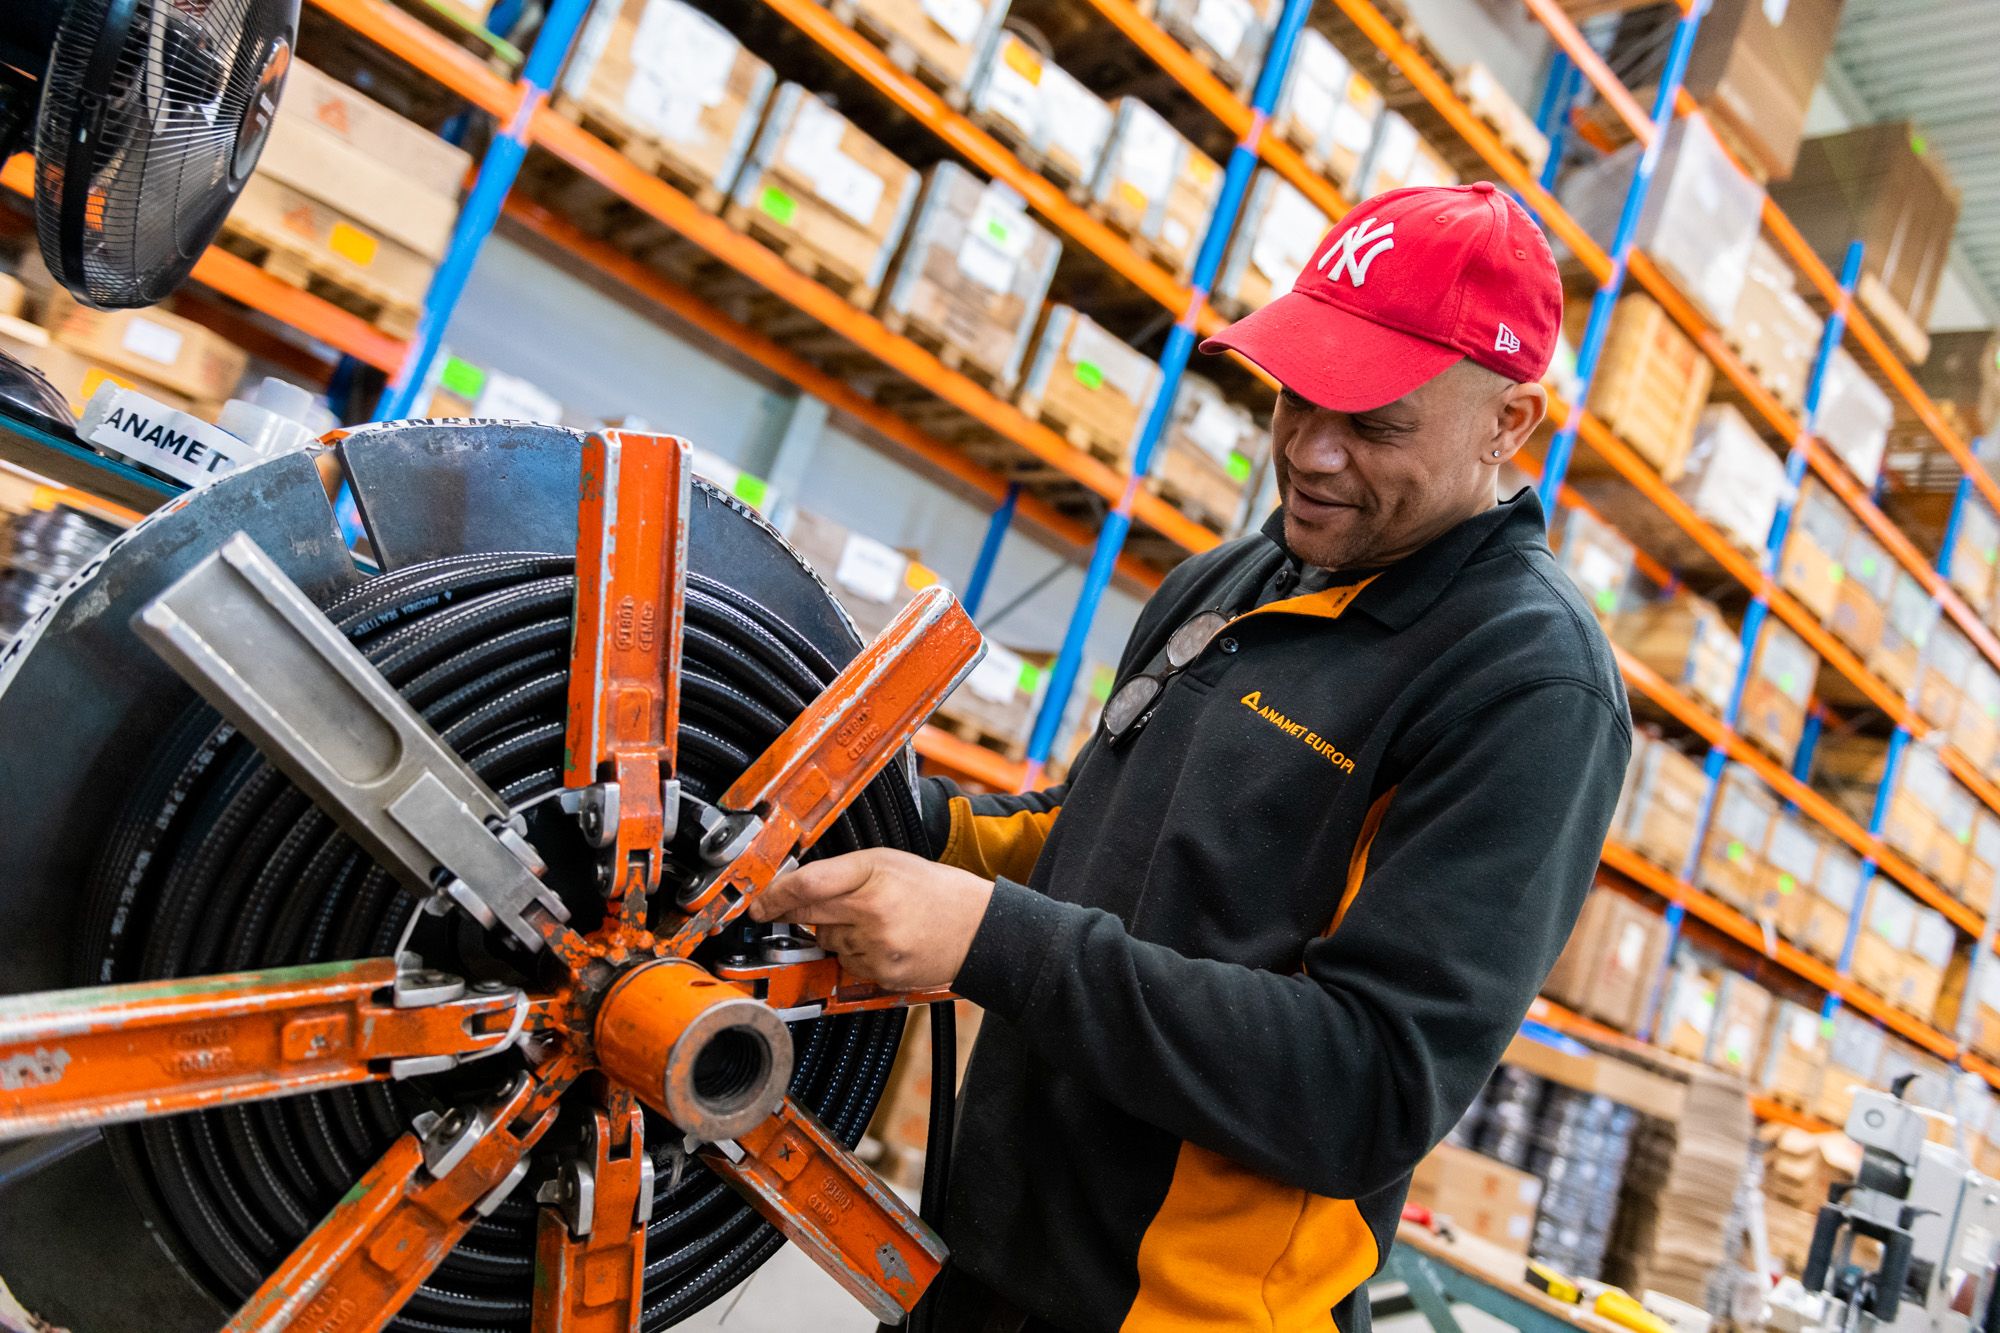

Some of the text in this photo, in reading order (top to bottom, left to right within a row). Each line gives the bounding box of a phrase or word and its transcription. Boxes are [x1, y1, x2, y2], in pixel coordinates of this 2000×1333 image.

[1317, 217, 1394, 288] NY
[105, 407, 230, 473] ANAMET
[1257, 705, 1308, 738] ANAMET
